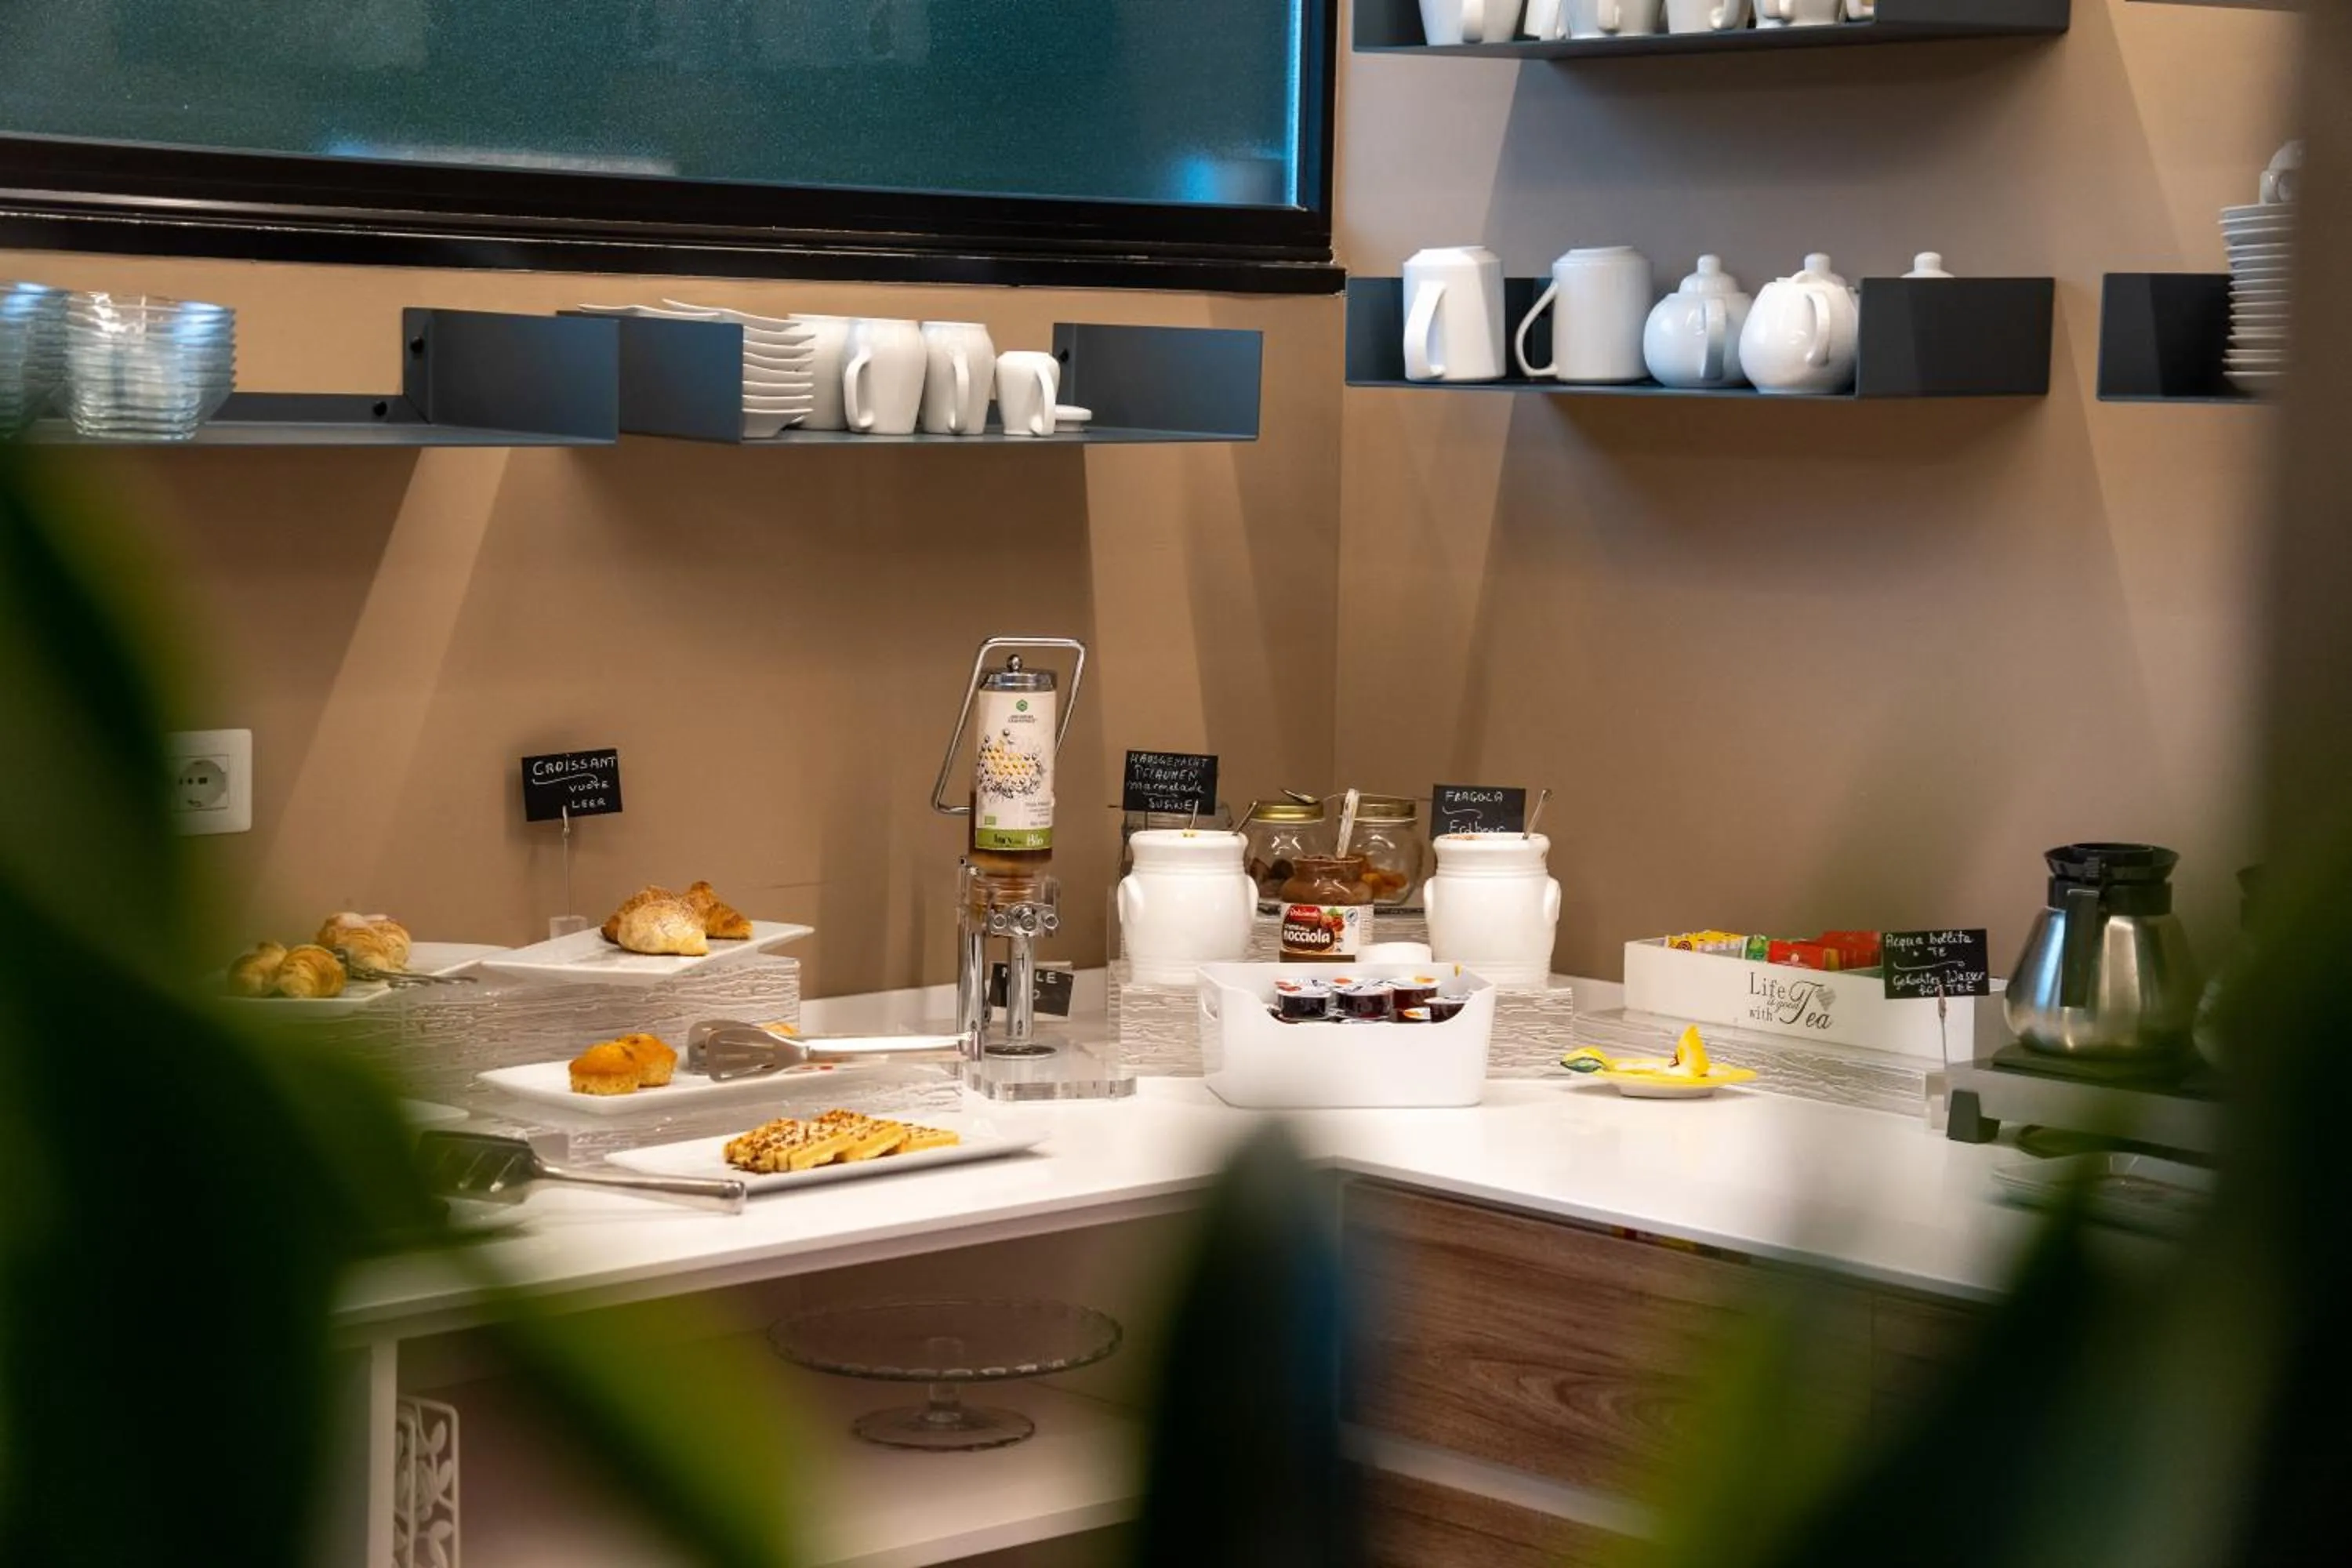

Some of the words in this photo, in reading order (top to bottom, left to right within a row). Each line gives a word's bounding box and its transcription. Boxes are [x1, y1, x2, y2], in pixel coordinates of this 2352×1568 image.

[532, 757, 615, 775] CROISSANT
[572, 797, 606, 809] LEER
[1445, 790, 1504, 804] FRAGOLA
[1749, 971, 1786, 1000] Life
[1778, 979, 1833, 1029] Tea
[1749, 1007, 1773, 1022] with
